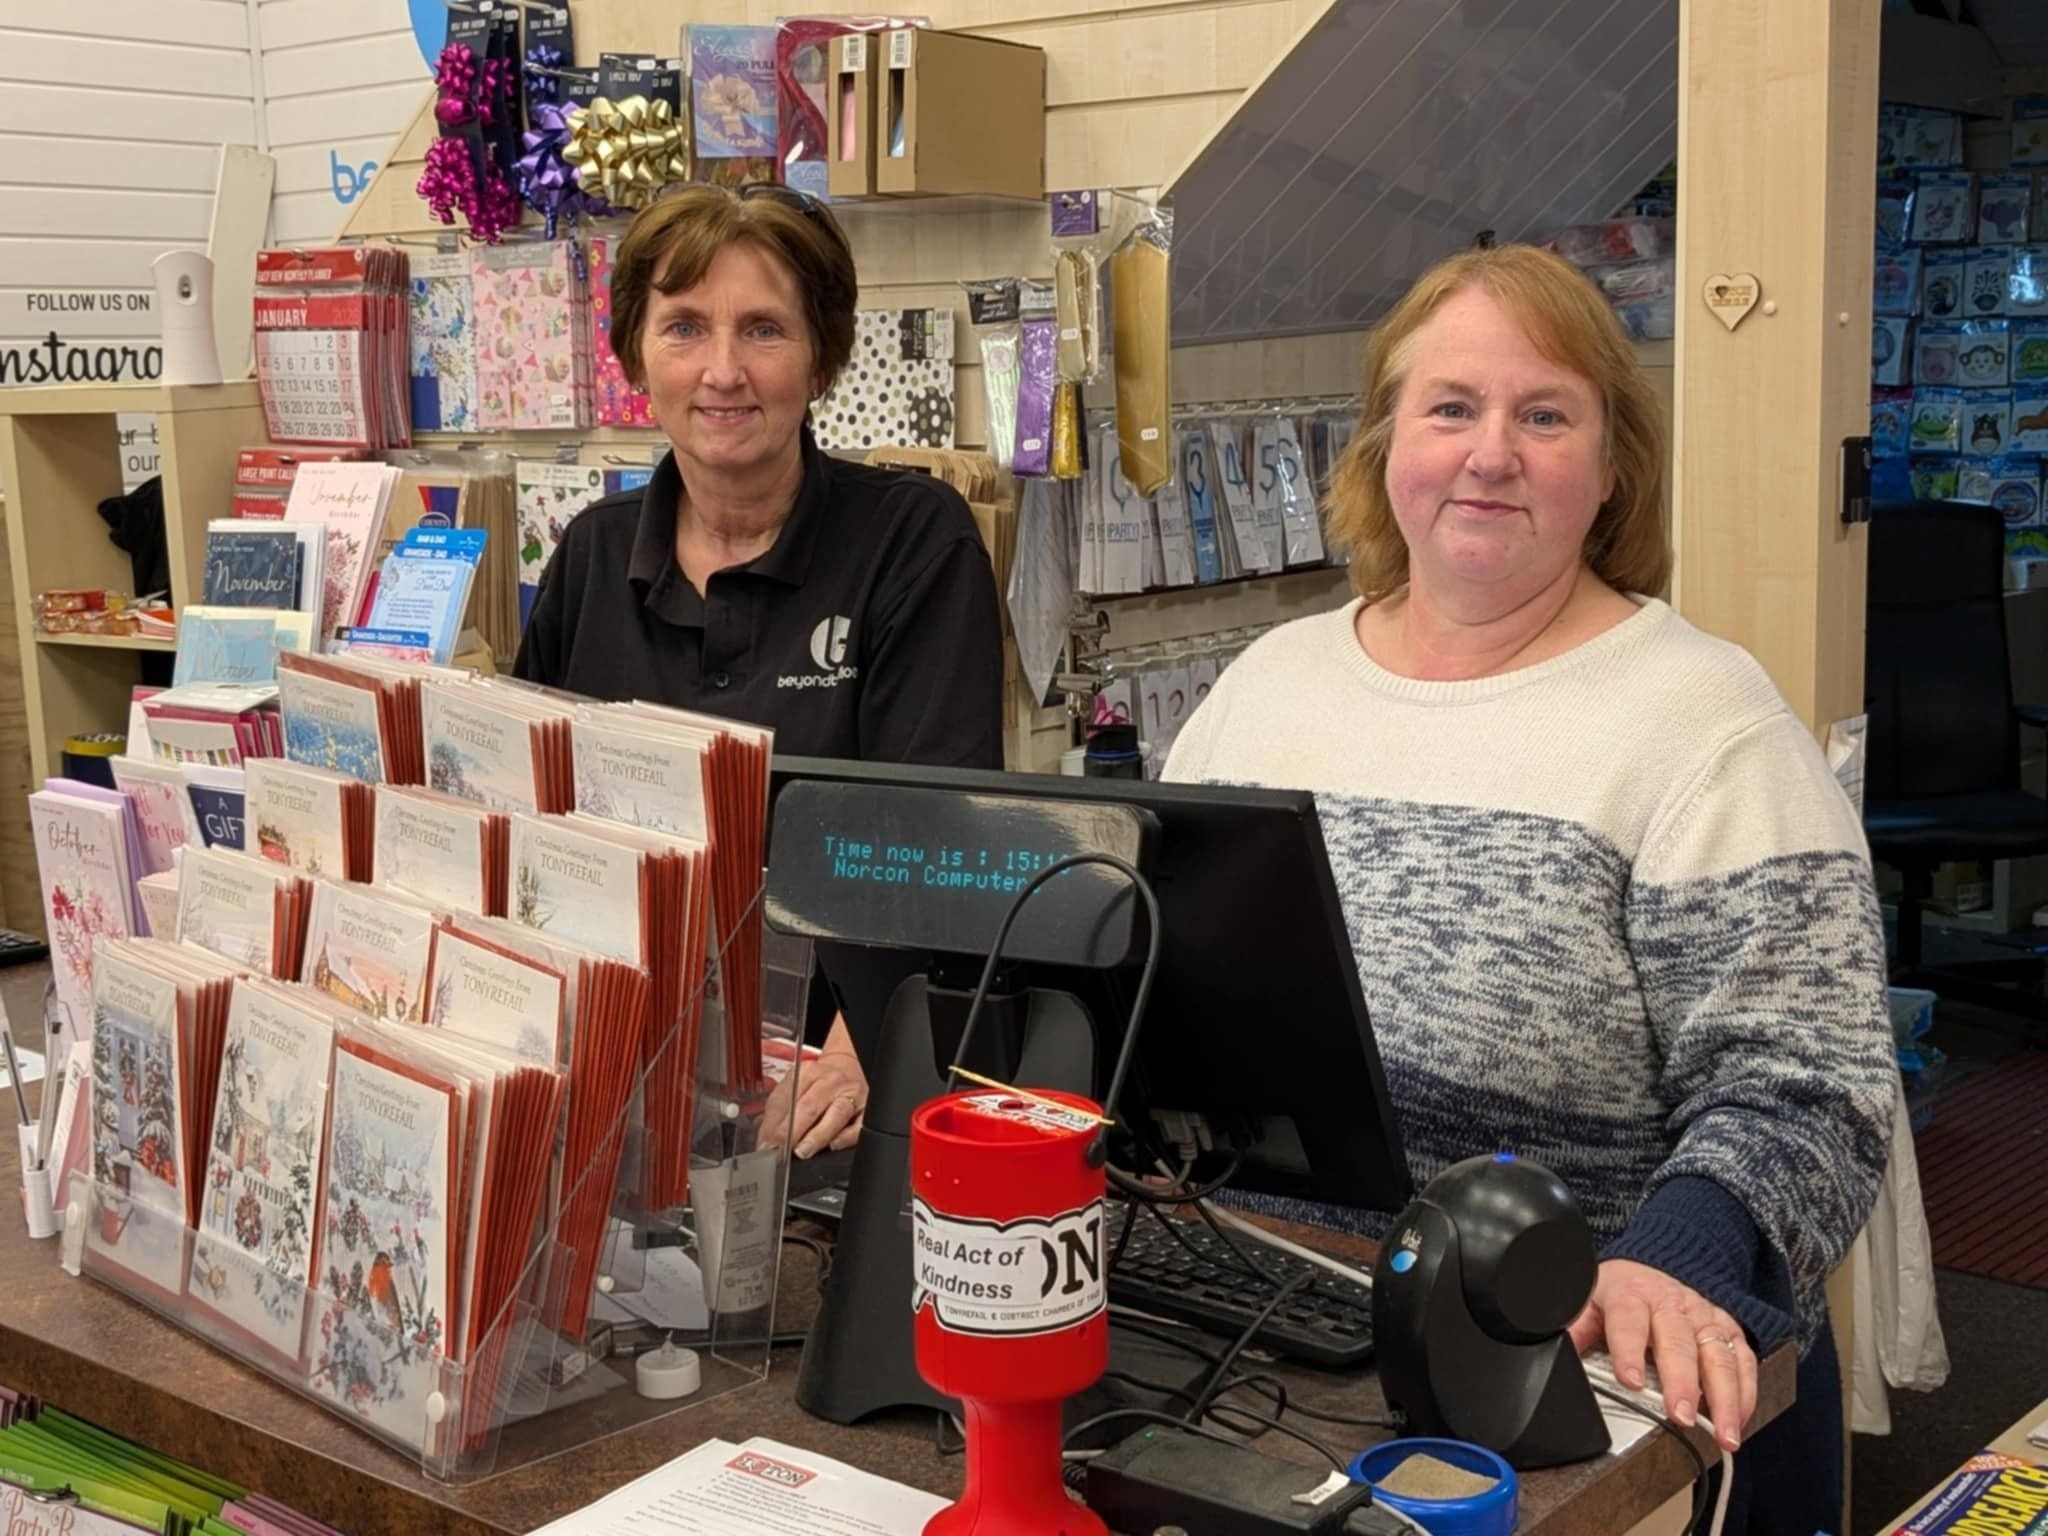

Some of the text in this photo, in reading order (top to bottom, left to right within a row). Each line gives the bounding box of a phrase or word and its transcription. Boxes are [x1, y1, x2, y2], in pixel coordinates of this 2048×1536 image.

[27, 294, 150, 311] FOLLOW US ON
[256, 309, 307, 327] JANUARY
[313, 335, 319, 348] 1
[326, 335, 334, 348] 2
[212, 559, 288, 594] November
[601, 759, 666, 786] TONYREFAIL
[218, 797, 229, 810] A
[47, 820, 104, 858] October
[824, 836, 872, 859] Time
[886, 845, 924, 863] now
[940, 845, 963, 866] is
[979, 850, 988, 866] :
[541, 853, 603, 887] TONYREFAIL
[834, 857, 1041, 895] Norcon Computer
[464, 973, 524, 1014] TONYREFAIL
[360, 1090, 416, 1130] TONYREFAIL
[917, 1227, 1025, 1267] Real Act of
[921, 1262, 1013, 1300] Kindness
